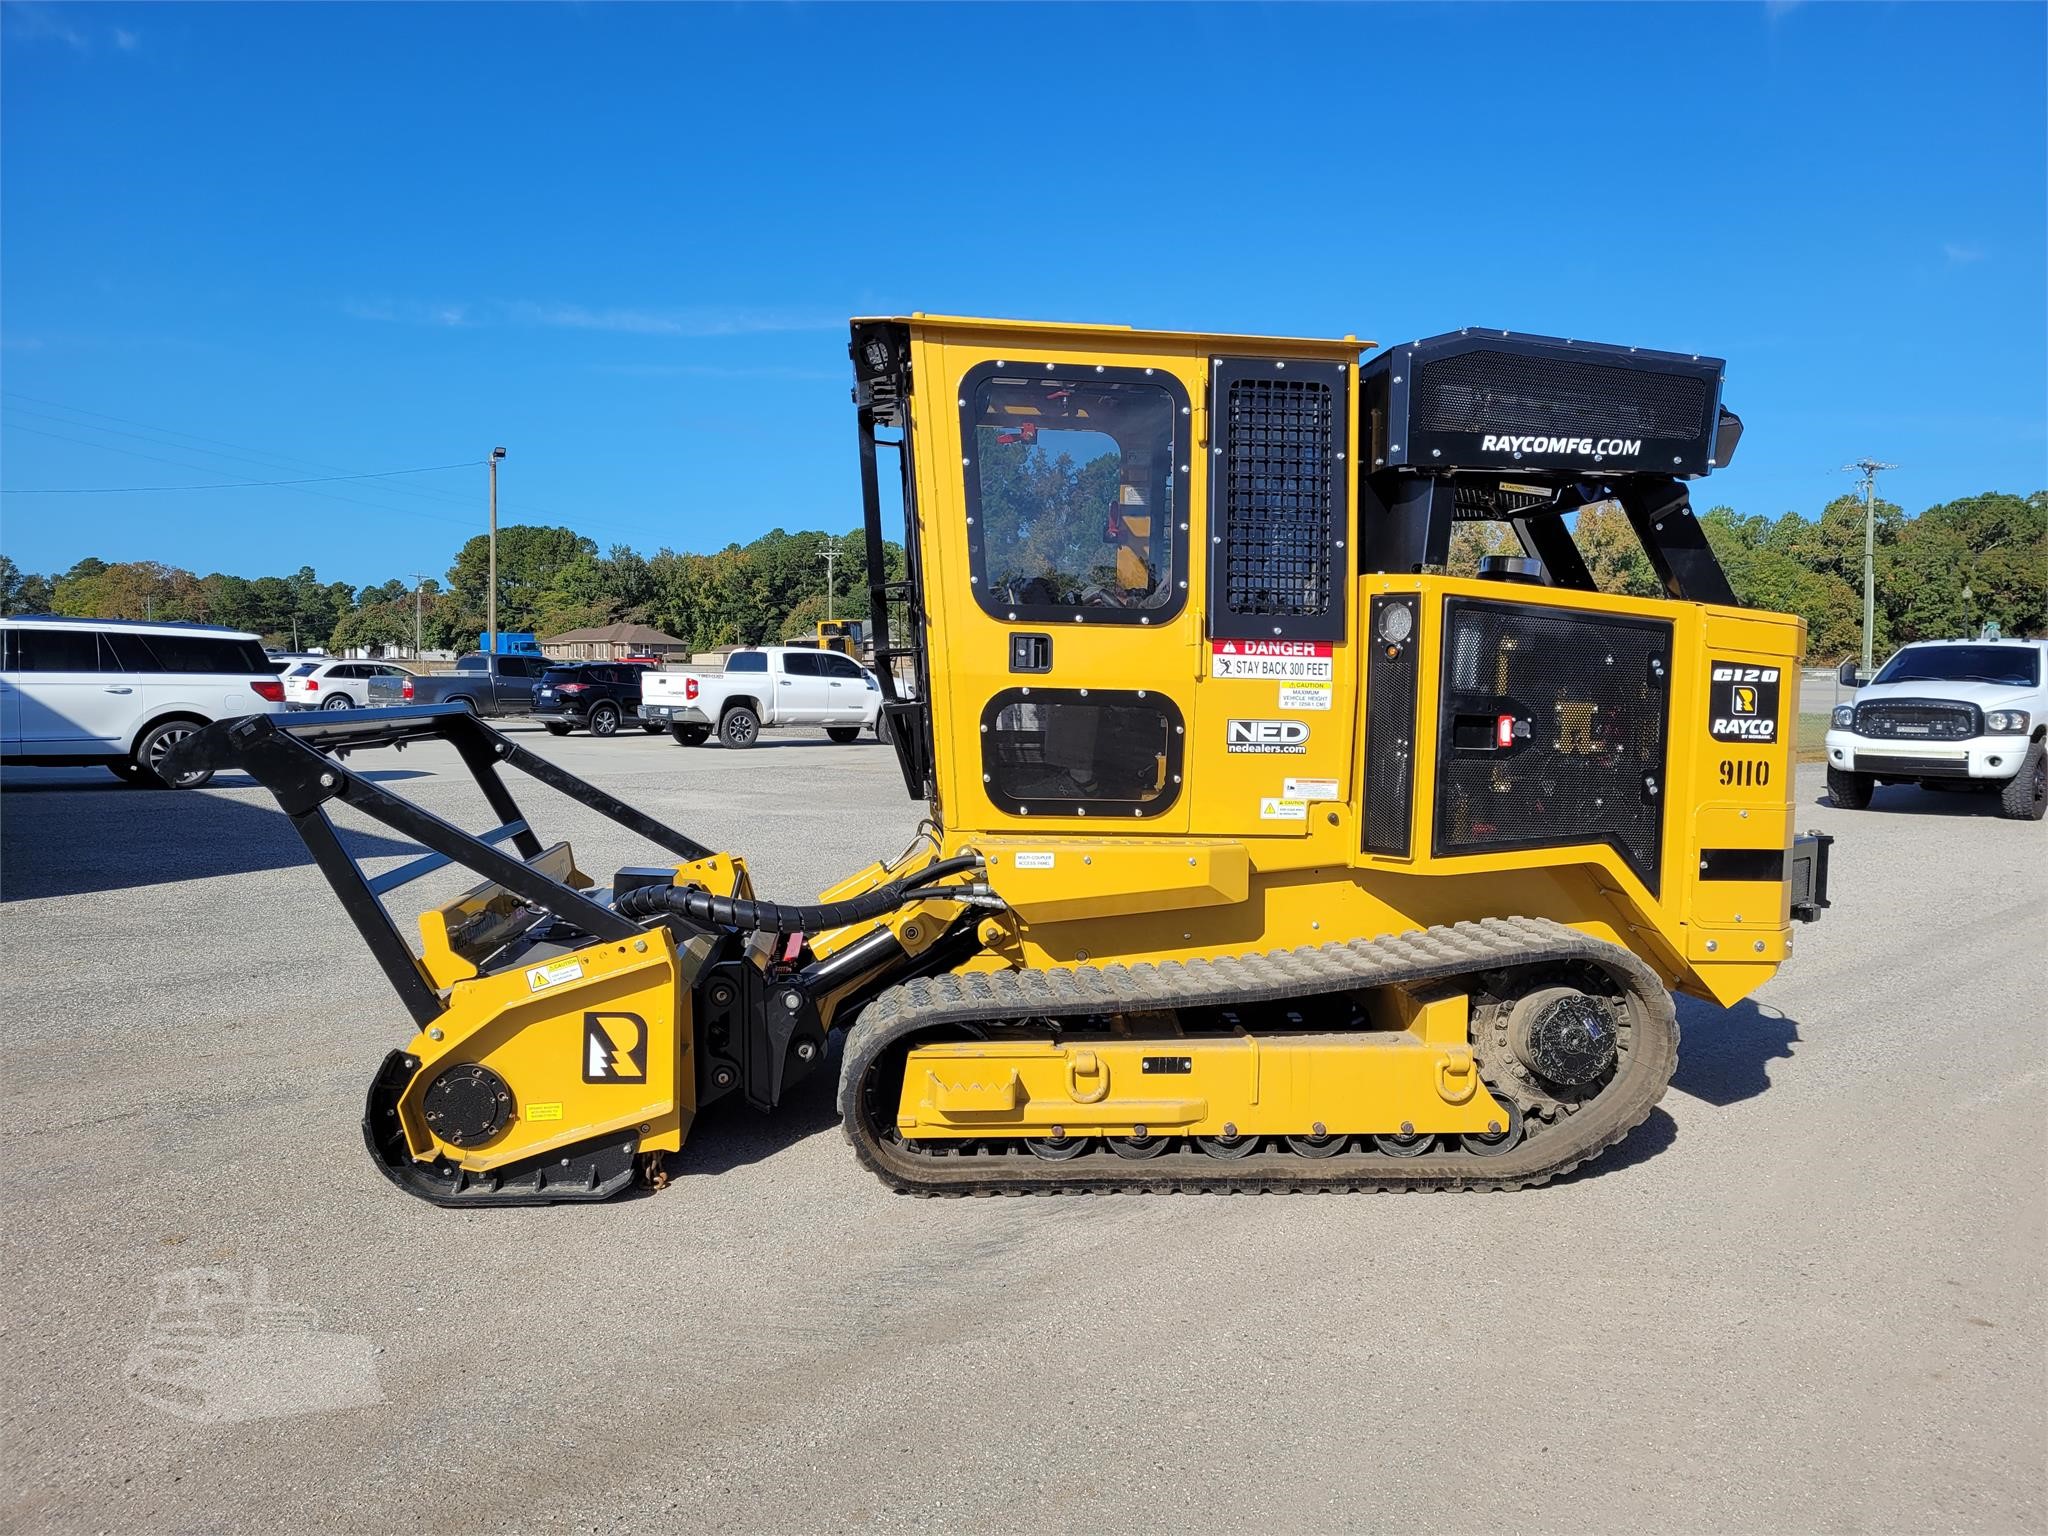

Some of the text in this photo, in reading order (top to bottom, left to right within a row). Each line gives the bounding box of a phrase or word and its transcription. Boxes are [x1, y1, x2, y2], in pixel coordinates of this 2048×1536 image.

[1482, 435, 1641, 456] RAYCOMFG.COM
[1244, 641, 1316, 656] DANGER
[1236, 661, 1329, 676] STAY BACK 300 FEET
[1712, 668, 1779, 683] C120
[1229, 721, 1309, 743] NED
[1712, 719, 1774, 735] RAYCO
[1228, 743, 1306, 754] nedealers.com
[1719, 760, 1770, 786] 9110
